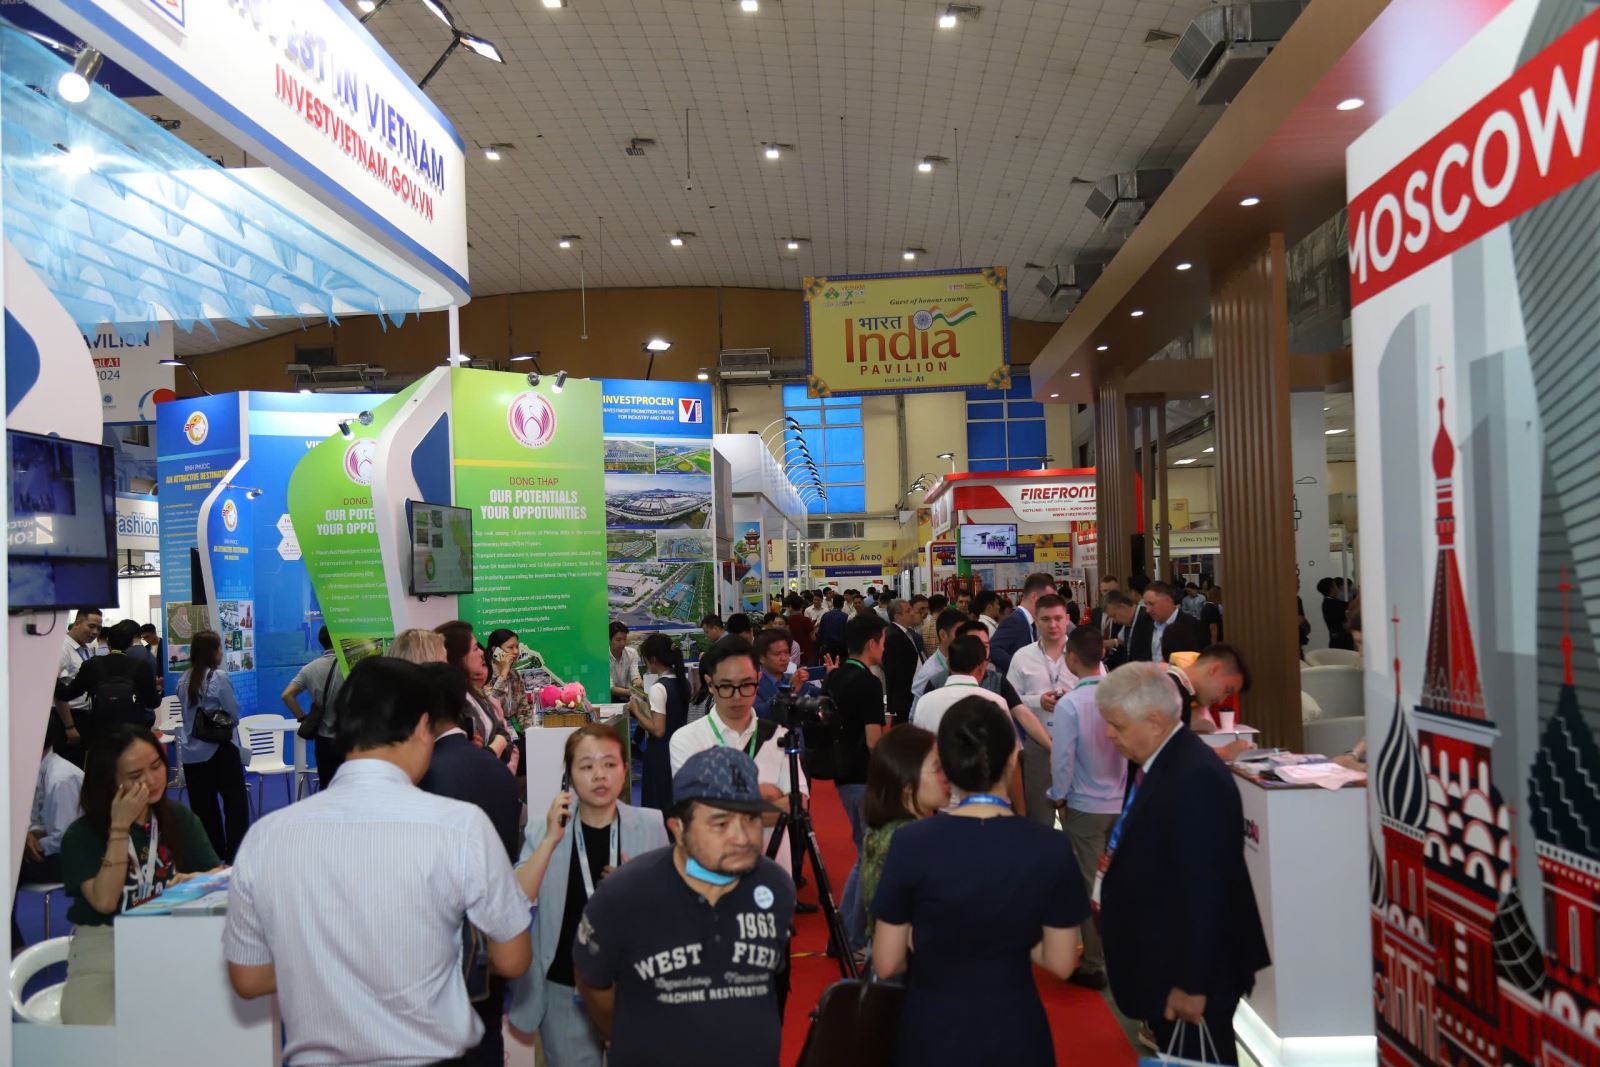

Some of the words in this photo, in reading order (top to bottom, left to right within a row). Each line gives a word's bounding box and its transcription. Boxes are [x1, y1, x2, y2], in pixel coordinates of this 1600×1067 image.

[275, 63, 434, 221] INVESTVIETNAM.GOV.VN
[366, 83, 445, 191] VIETNAM
[890, 298, 909, 306] Guest
[910, 297, 918, 305] of
[944, 295, 970, 304] country
[859, 315, 902, 331] भारत
[845, 315, 961, 363] India
[860, 361, 948, 376] PAVILION
[603, 395, 674, 406] INVESTPROCEN
[509, 476, 535, 486] DONG
[538, 477, 560, 486] THAP
[490, 489, 513, 504] OUR
[515, 489, 579, 505] POTENTIALS
[1021, 486, 1097, 500] FIREFRONT
[343, 498, 368, 506] DONG
[325, 509, 346, 522] OUR
[480, 505, 510, 520] YOUR
[512, 506, 588, 520] OPPOTUNITIES
[316, 523, 343, 536] YOUR
[821, 548, 856, 562] India
[736, 912, 777, 939] 1963
[634, 943, 703, 981] WEST
